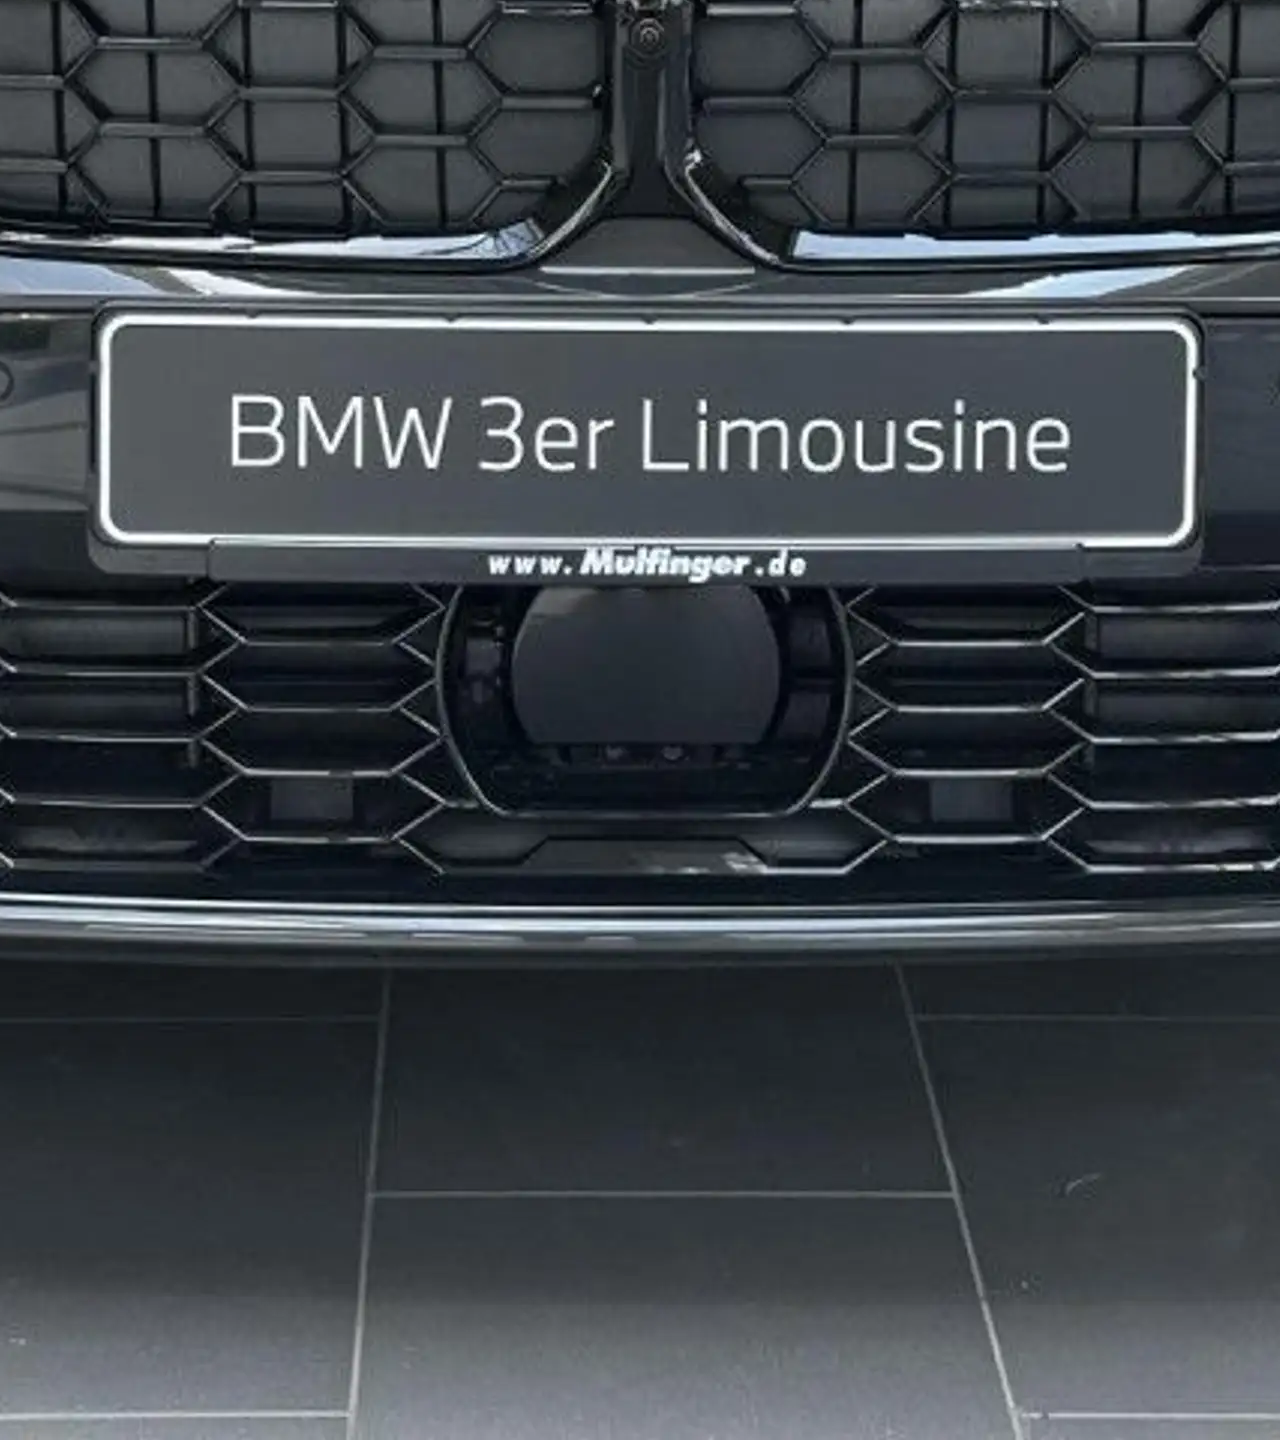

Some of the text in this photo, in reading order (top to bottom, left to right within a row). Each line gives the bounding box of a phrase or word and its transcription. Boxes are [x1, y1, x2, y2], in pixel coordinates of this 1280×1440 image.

[230, 392, 1071, 474] BMW 3er Limousine
